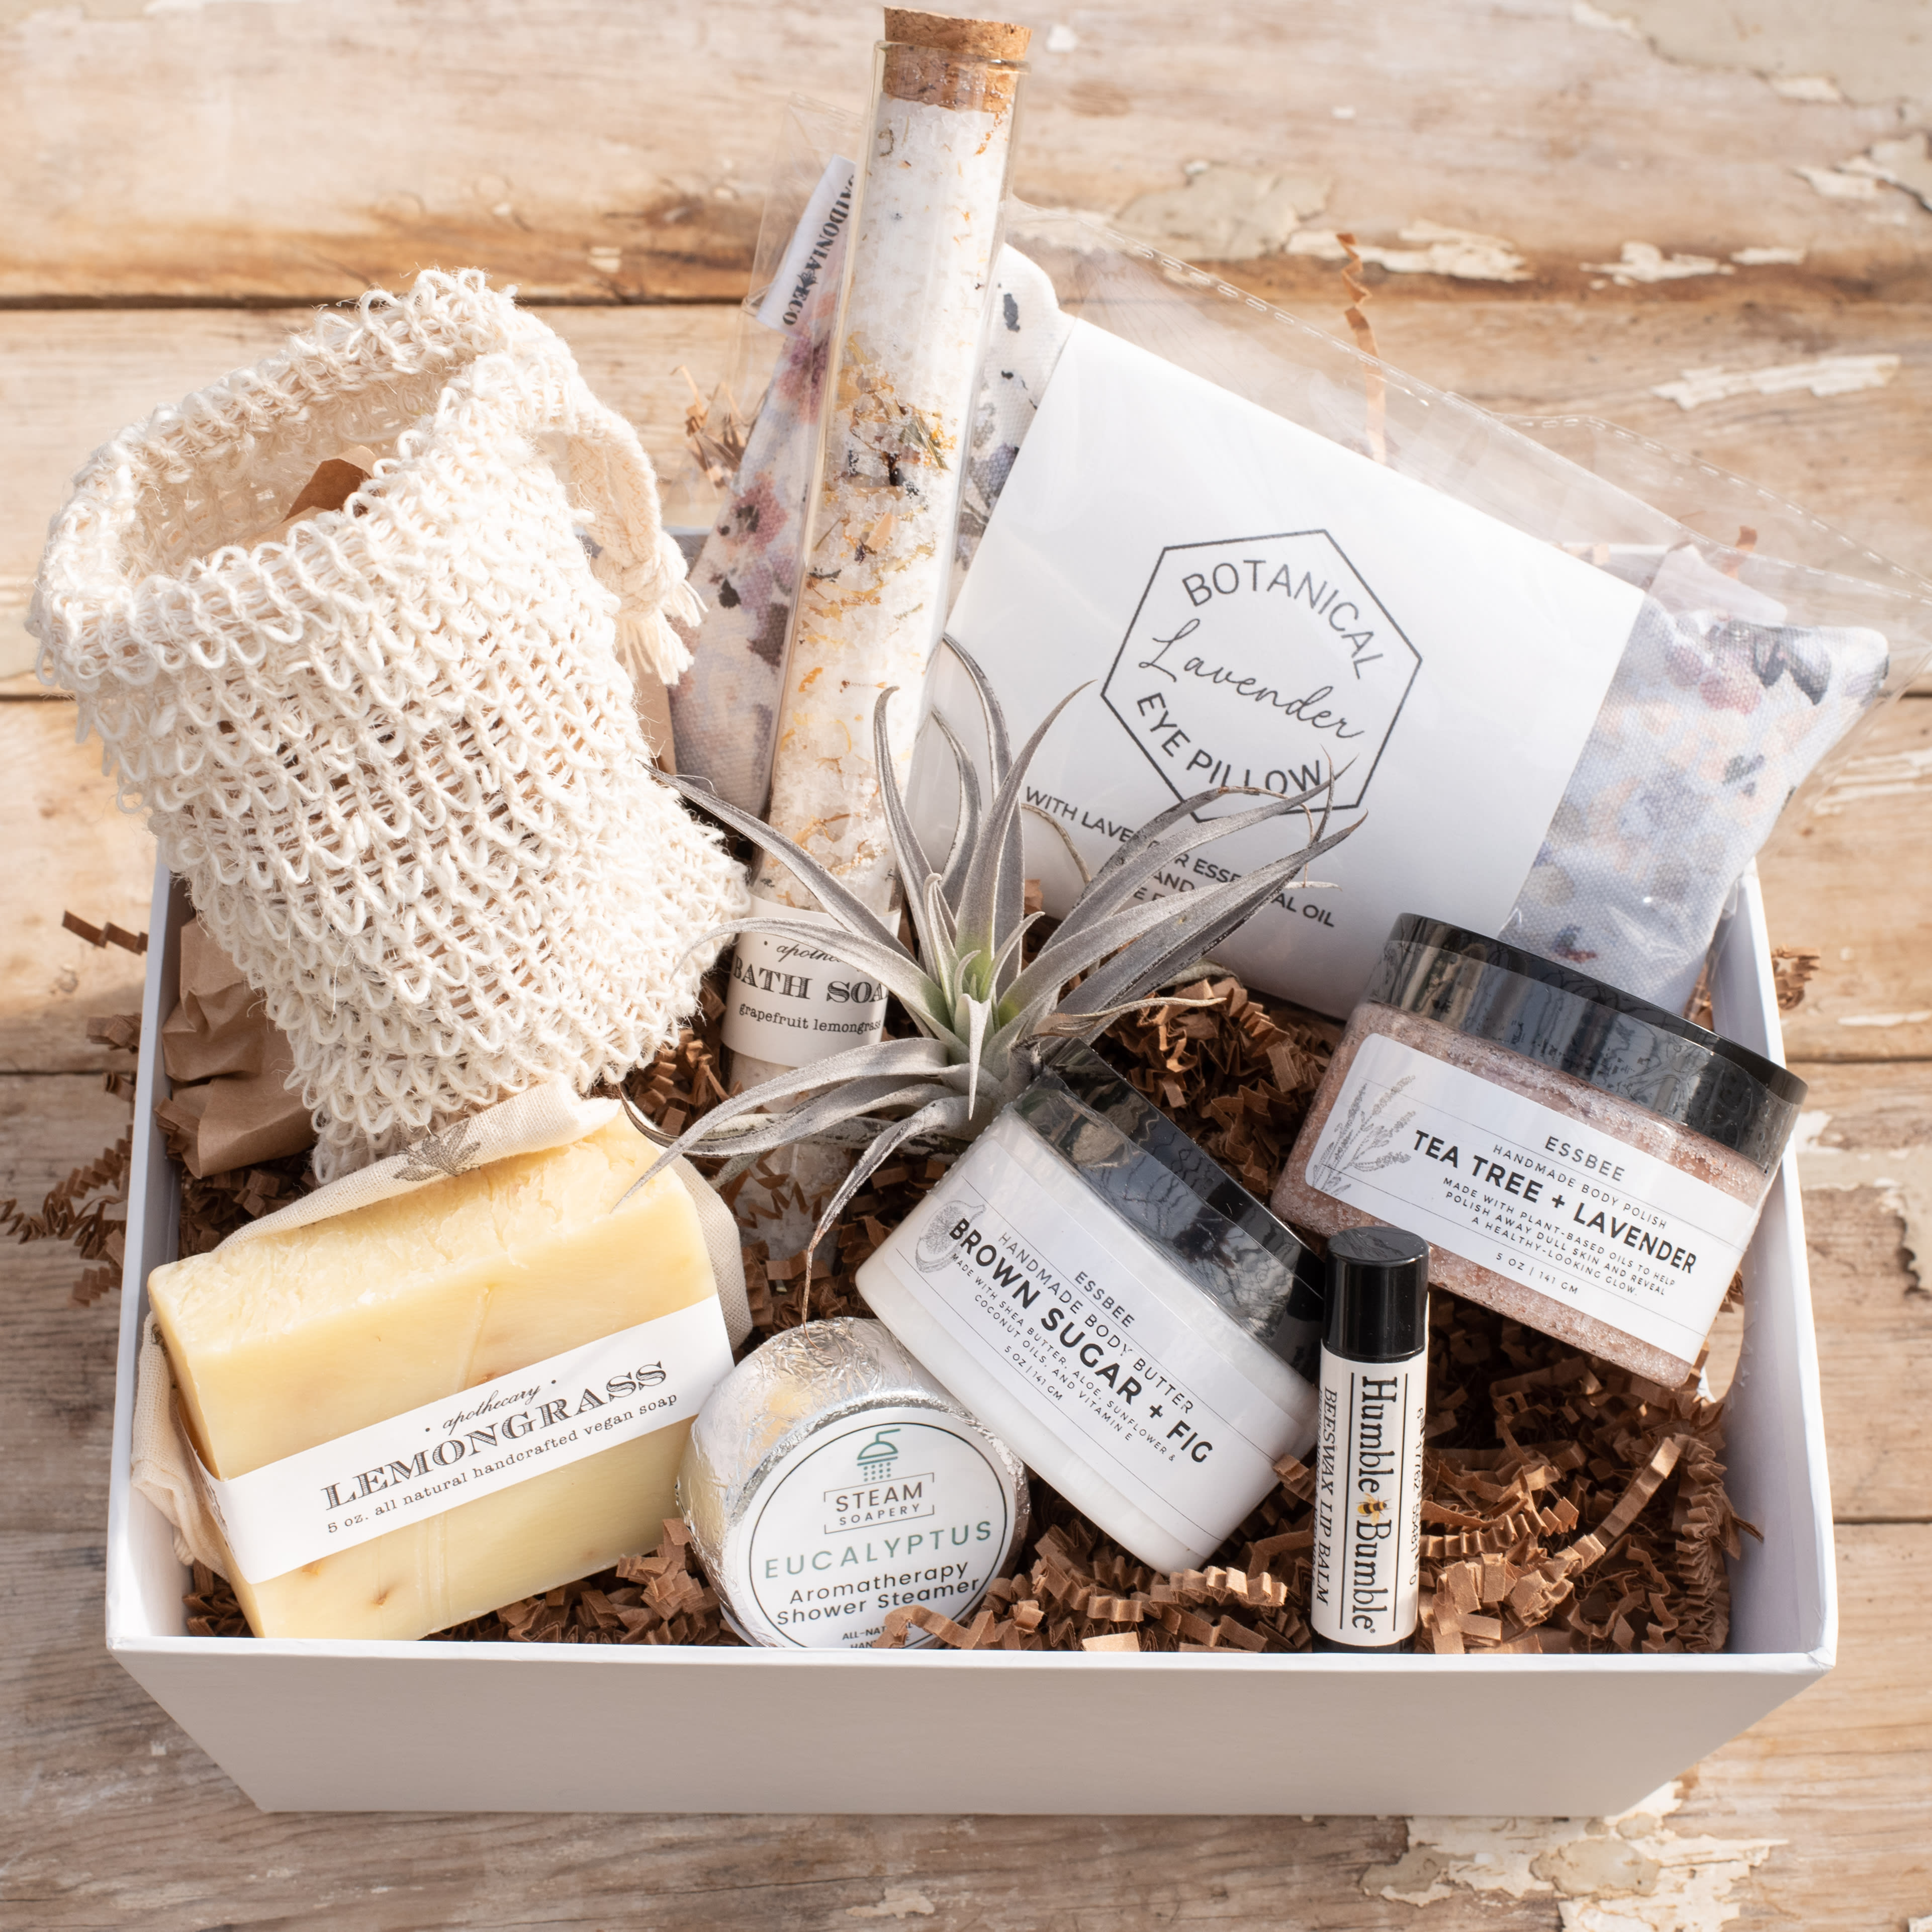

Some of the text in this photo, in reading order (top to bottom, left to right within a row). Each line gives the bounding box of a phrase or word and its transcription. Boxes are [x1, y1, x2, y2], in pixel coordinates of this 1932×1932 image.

[782, 286, 810, 325] ECO
[1182, 560, 1384, 679] BOTANICAL
[1138, 618, 1364, 739] Lavender
[1137, 693, 1321, 796] EYE PILLOW
[1026, 786, 1078, 821] WITH
[1081, 811, 1190, 868] LAVER
[1303, 904, 1334, 928] OIL
[733, 956, 889, 1004] BATH SOA
[739, 1003, 881, 1035] grapefruit lemongrass
[1493, 1144, 1667, 1229] HANDMADE BODY POLISH
[1544, 1136, 1625, 1181] ESSBEE
[1414, 1130, 1458, 1168] TEA
[1472, 1155, 1543, 1203] TREE
[1573, 1202, 1697, 1274] LAVENDER
[1443, 1177, 1675, 1285] MADE WITH PLANT-BASED OILS TO HELP
[1445, 1191, 1664, 1295] POLISH AWAY DULL SKIN AND REVEAL
[1471, 1217, 1479, 1225] A
[1485, 1222, 1601, 1278] HEALTHY-LOOKING
[1496, 1252, 1503, 1260] 5
[1508, 1258, 1525, 1270] OZ
[1539, 1271, 1555, 1284] 141
[1561, 1282, 1578, 1294] GM
[998, 1232, 1193, 1414] HANDMADE BODY BUTTER
[1074, 1271, 1135, 1328] ESSBEE
[949, 1218, 1041, 1310] BROWN
[1041, 1308, 1142, 1405] SUGAR
[1166, 1420, 1213, 1463] FIG
[950, 1253, 974, 1277] MADE
[975, 1276, 998, 1300] WITH
[999, 1301, 1024, 1327] SHEA
[1107, 1400, 1167, 1454] SUNFLOWER
[975, 1295, 1021, 1338] COCONUT
[1052, 1369, 1075, 1389] AND
[1079, 1391, 1123, 1432] VITAMIN
[1125, 1433, 1133, 1441] E
[1013, 1353, 1026, 1367] OZ
[1033, 1371, 1046, 1386] 141
[1047, 1386, 1063, 1401] GM
[320, 1360, 667, 1511] LEMONGRASS
[442, 1386, 540, 1436] apothecary
[1321, 1386, 1337, 1496] BEESWAX
[1357, 1376, 1398, 1493] Humble
[328, 1395, 677, 1533] 5 oz. all natural handcrafted vegan soap
[836, 1482, 922, 1512] STEAM
[766, 1520, 992, 1579] EUCALYPTUS
[839, 1503, 919, 1526] SOAPERY
[1320, 1499, 1332, 1537] LIP
[777, 1578, 979, 1625] Shower Steamer
[790, 1561, 968, 1604] Aromatherapy
[1316, 1540, 1330, 1606] BALM
